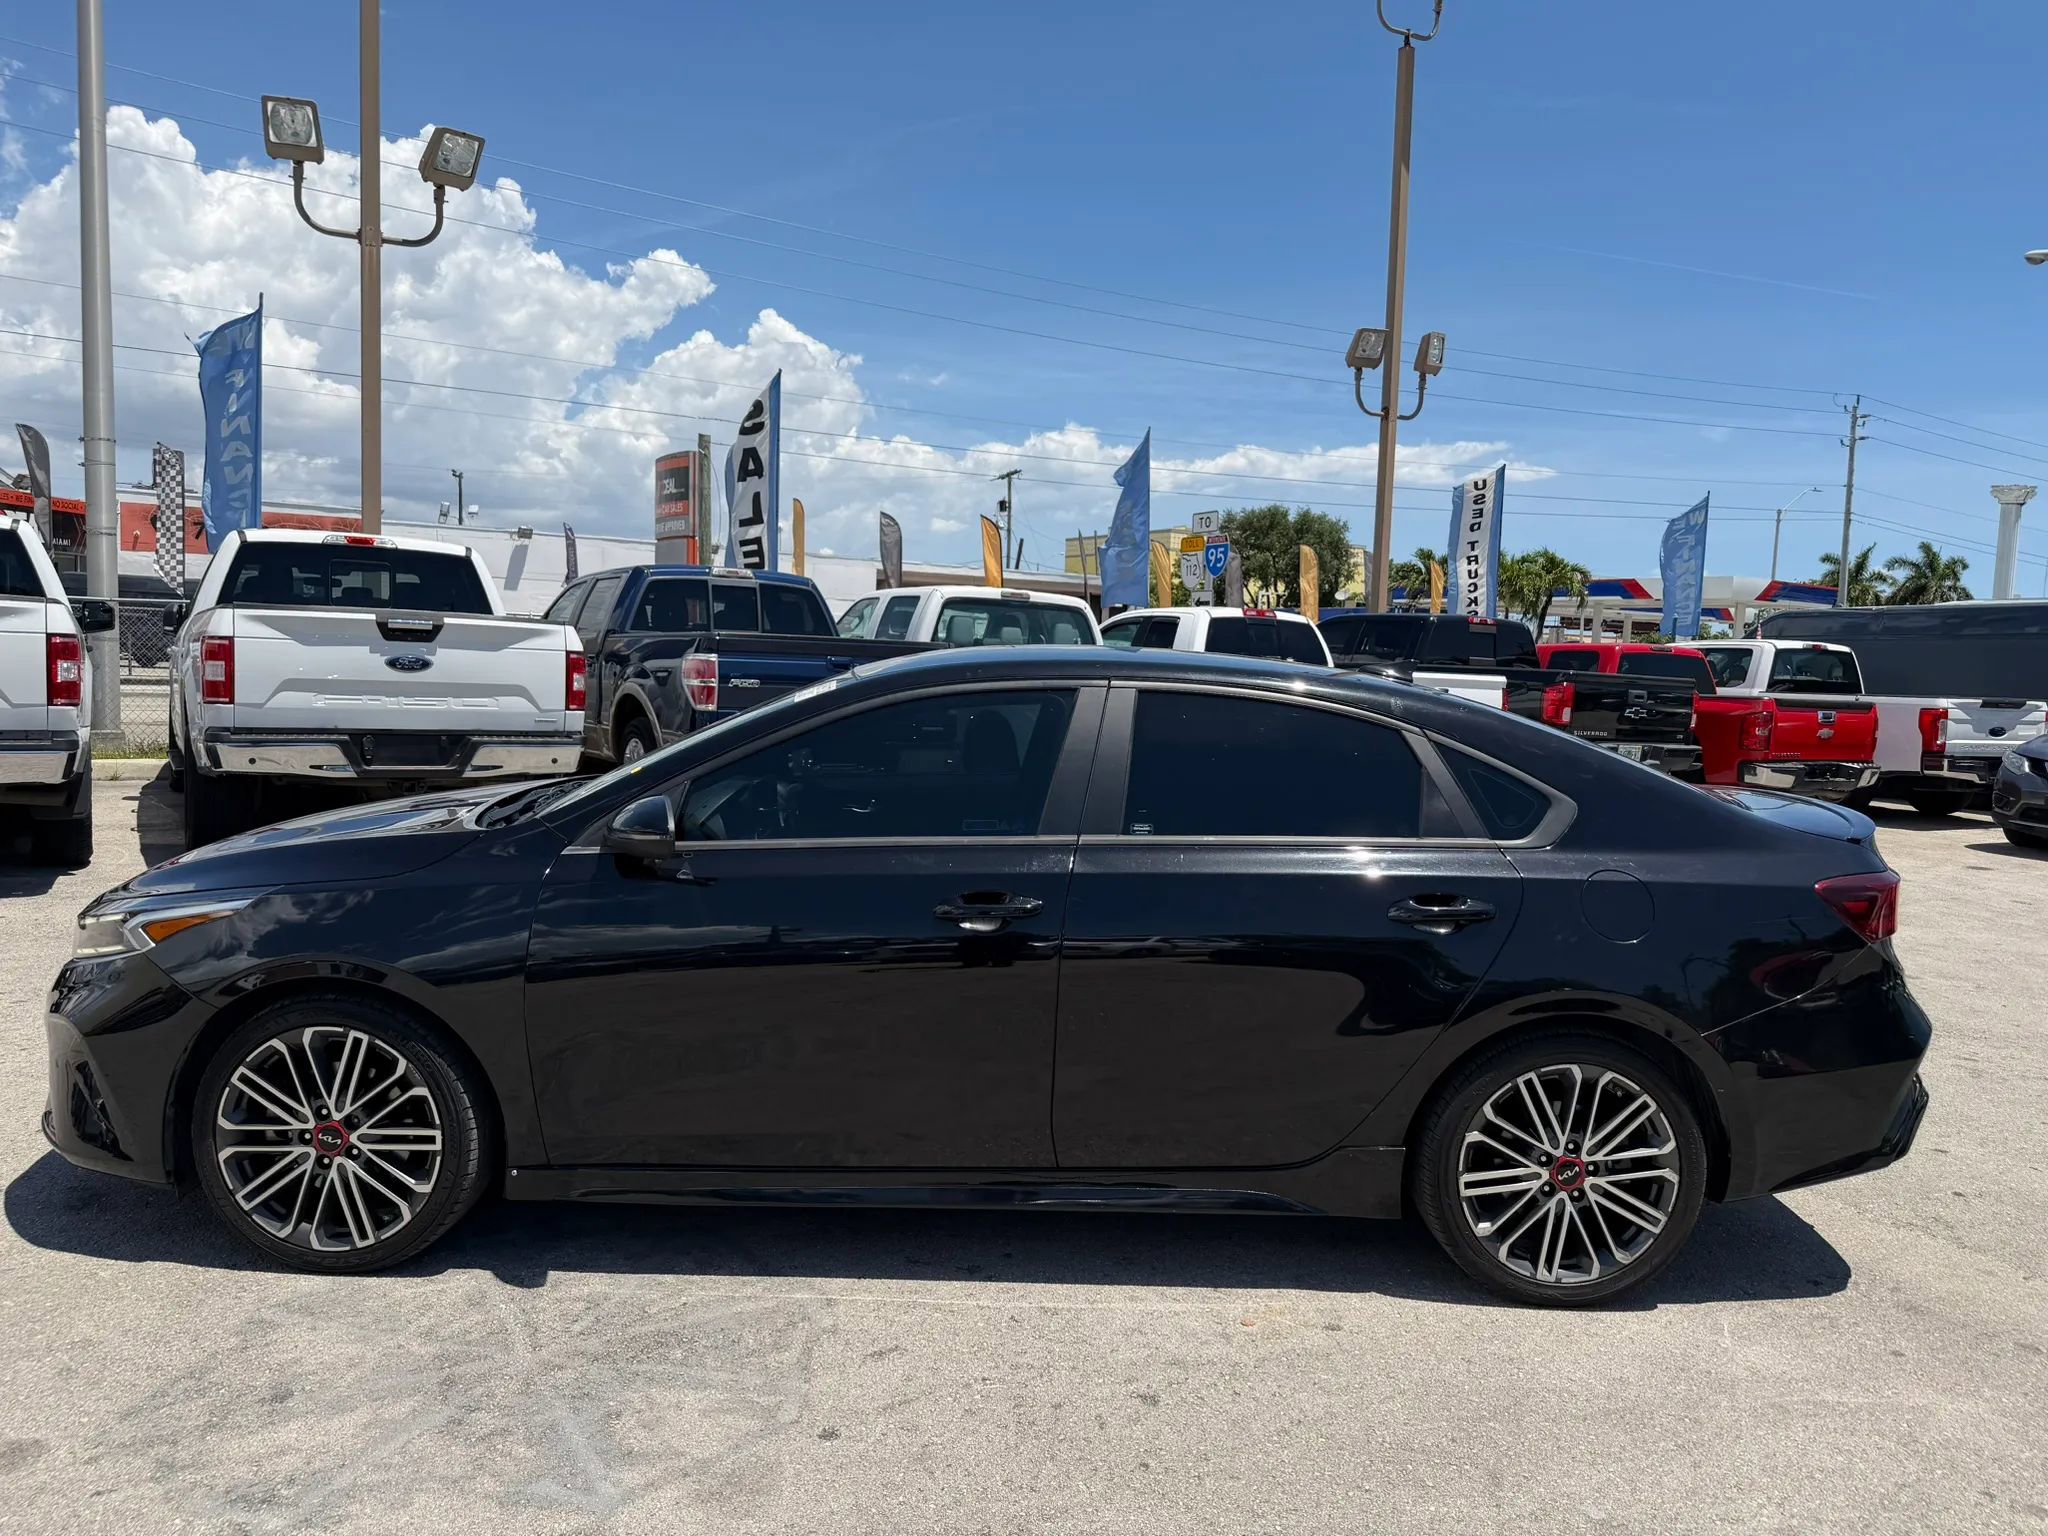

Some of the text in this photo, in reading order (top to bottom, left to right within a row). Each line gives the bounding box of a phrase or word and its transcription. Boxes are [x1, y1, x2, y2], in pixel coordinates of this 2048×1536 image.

[61, 501, 79, 510] SOCIAL
[1199, 516, 1212, 529] TO
[1185, 539, 1199, 549] TOLL
[1208, 547, 1225, 567] 95
[1186, 564, 1198, 577] 112
